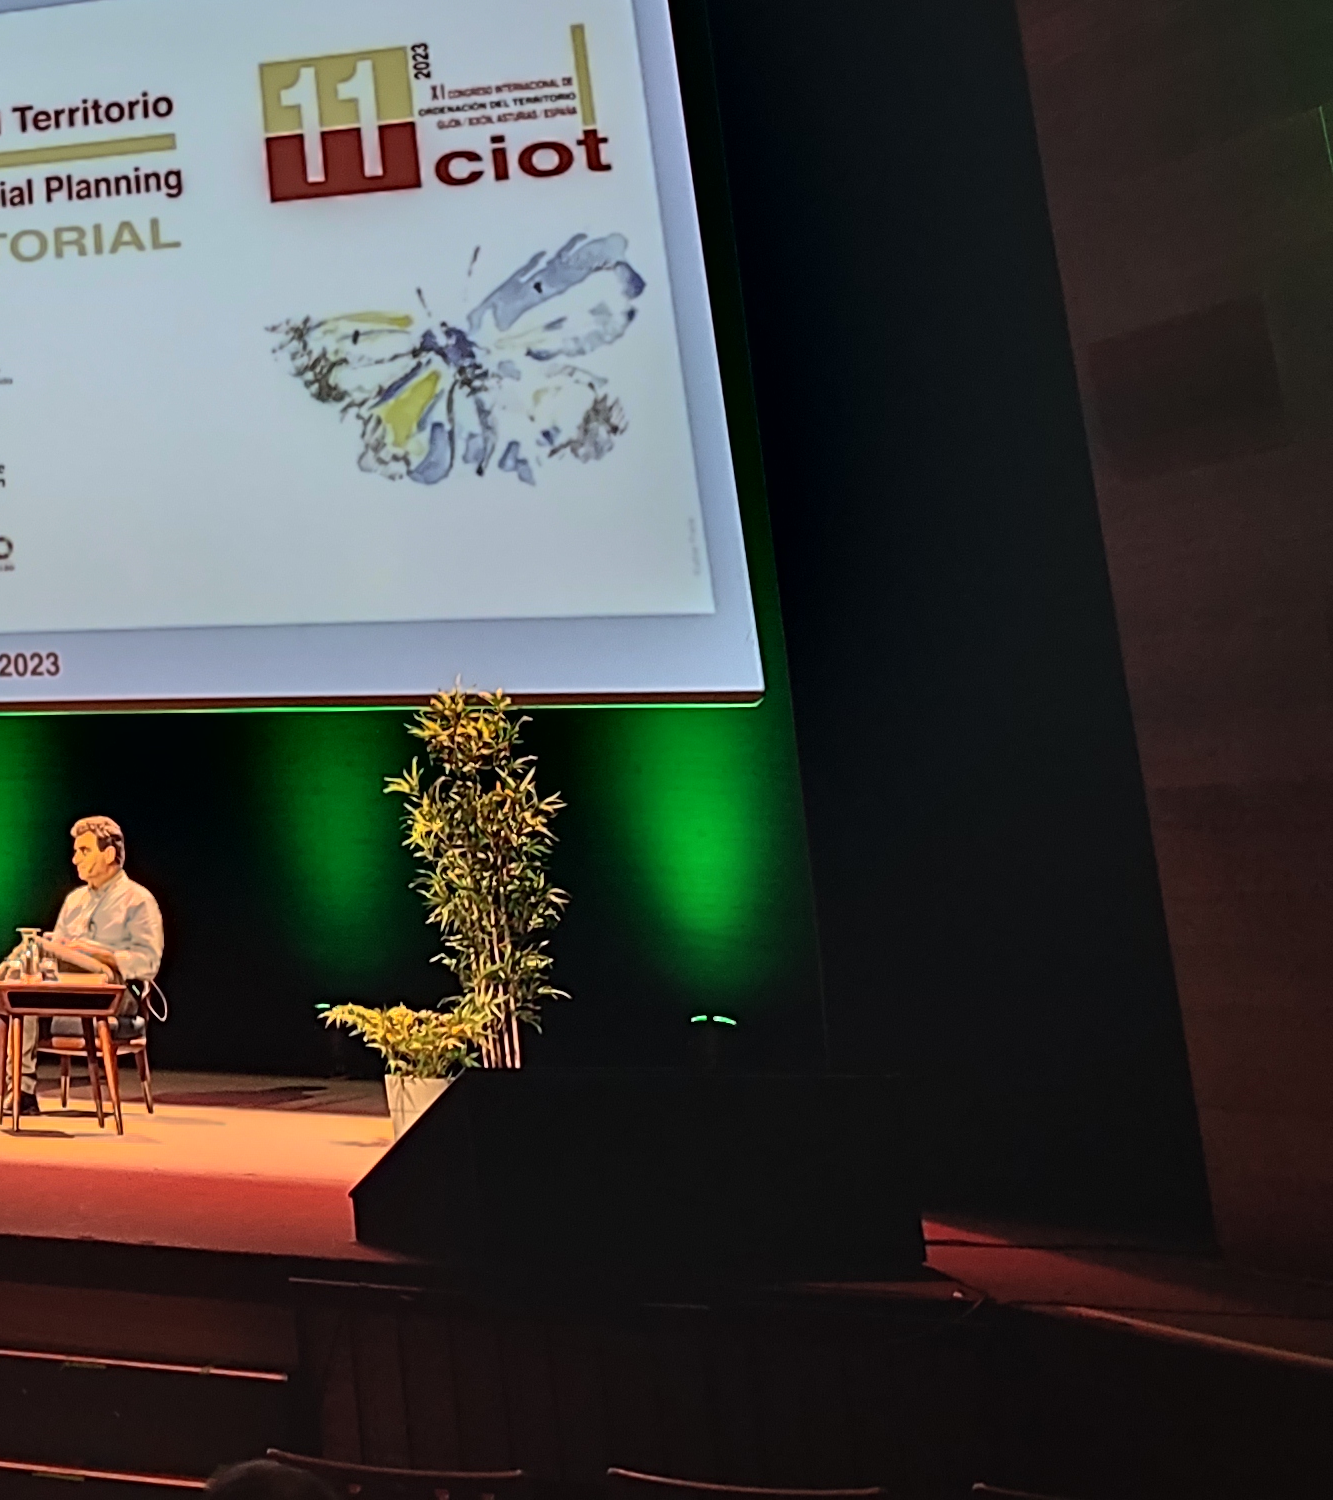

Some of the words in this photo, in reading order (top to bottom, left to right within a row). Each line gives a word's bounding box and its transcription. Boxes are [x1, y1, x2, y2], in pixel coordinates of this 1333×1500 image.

[411, 42, 431, 80] 2023
[11, 91, 174, 134] Territorio
[418, 100, 487, 116] ORDENACIÓN
[490, 98, 509, 109] DEL
[512, 92, 576, 106] TERRITORIO
[435, 129, 612, 186] ciot
[45, 167, 183, 203] Planning
